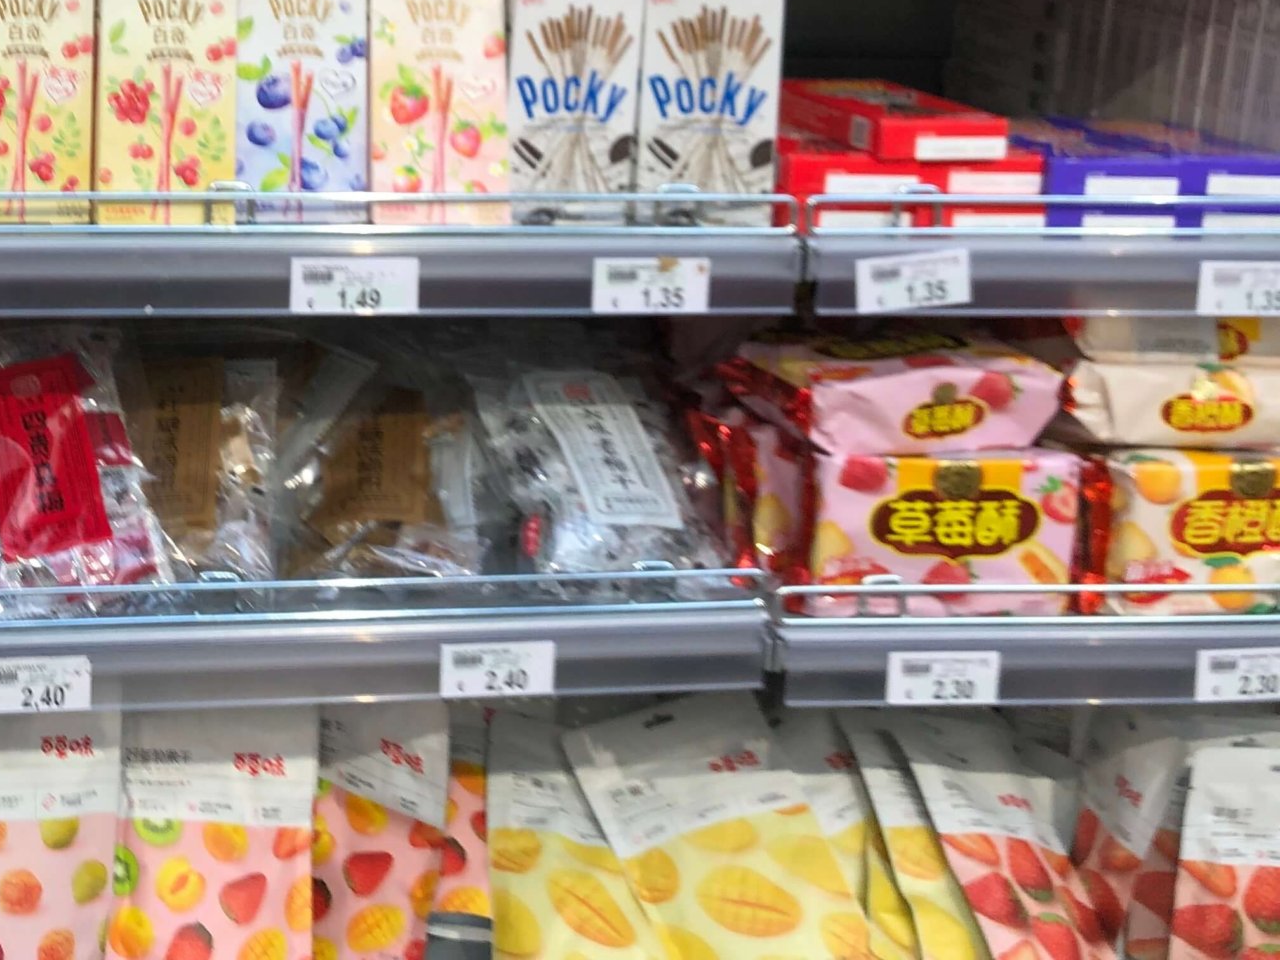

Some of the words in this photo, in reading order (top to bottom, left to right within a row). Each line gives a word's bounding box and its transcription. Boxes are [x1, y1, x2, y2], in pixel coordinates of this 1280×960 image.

[337, 288, 381, 311] 1,49
[641, 286, 685, 310] 1,35
[906, 280, 948, 305] 1,35
[887, 499, 1020, 546] 草莓酥
[1184, 499, 1280, 545] 香橙
[485, 668, 528, 694] 2,40
[933, 679, 975, 702] 2,30
[21, 686, 66, 714] 2,40
